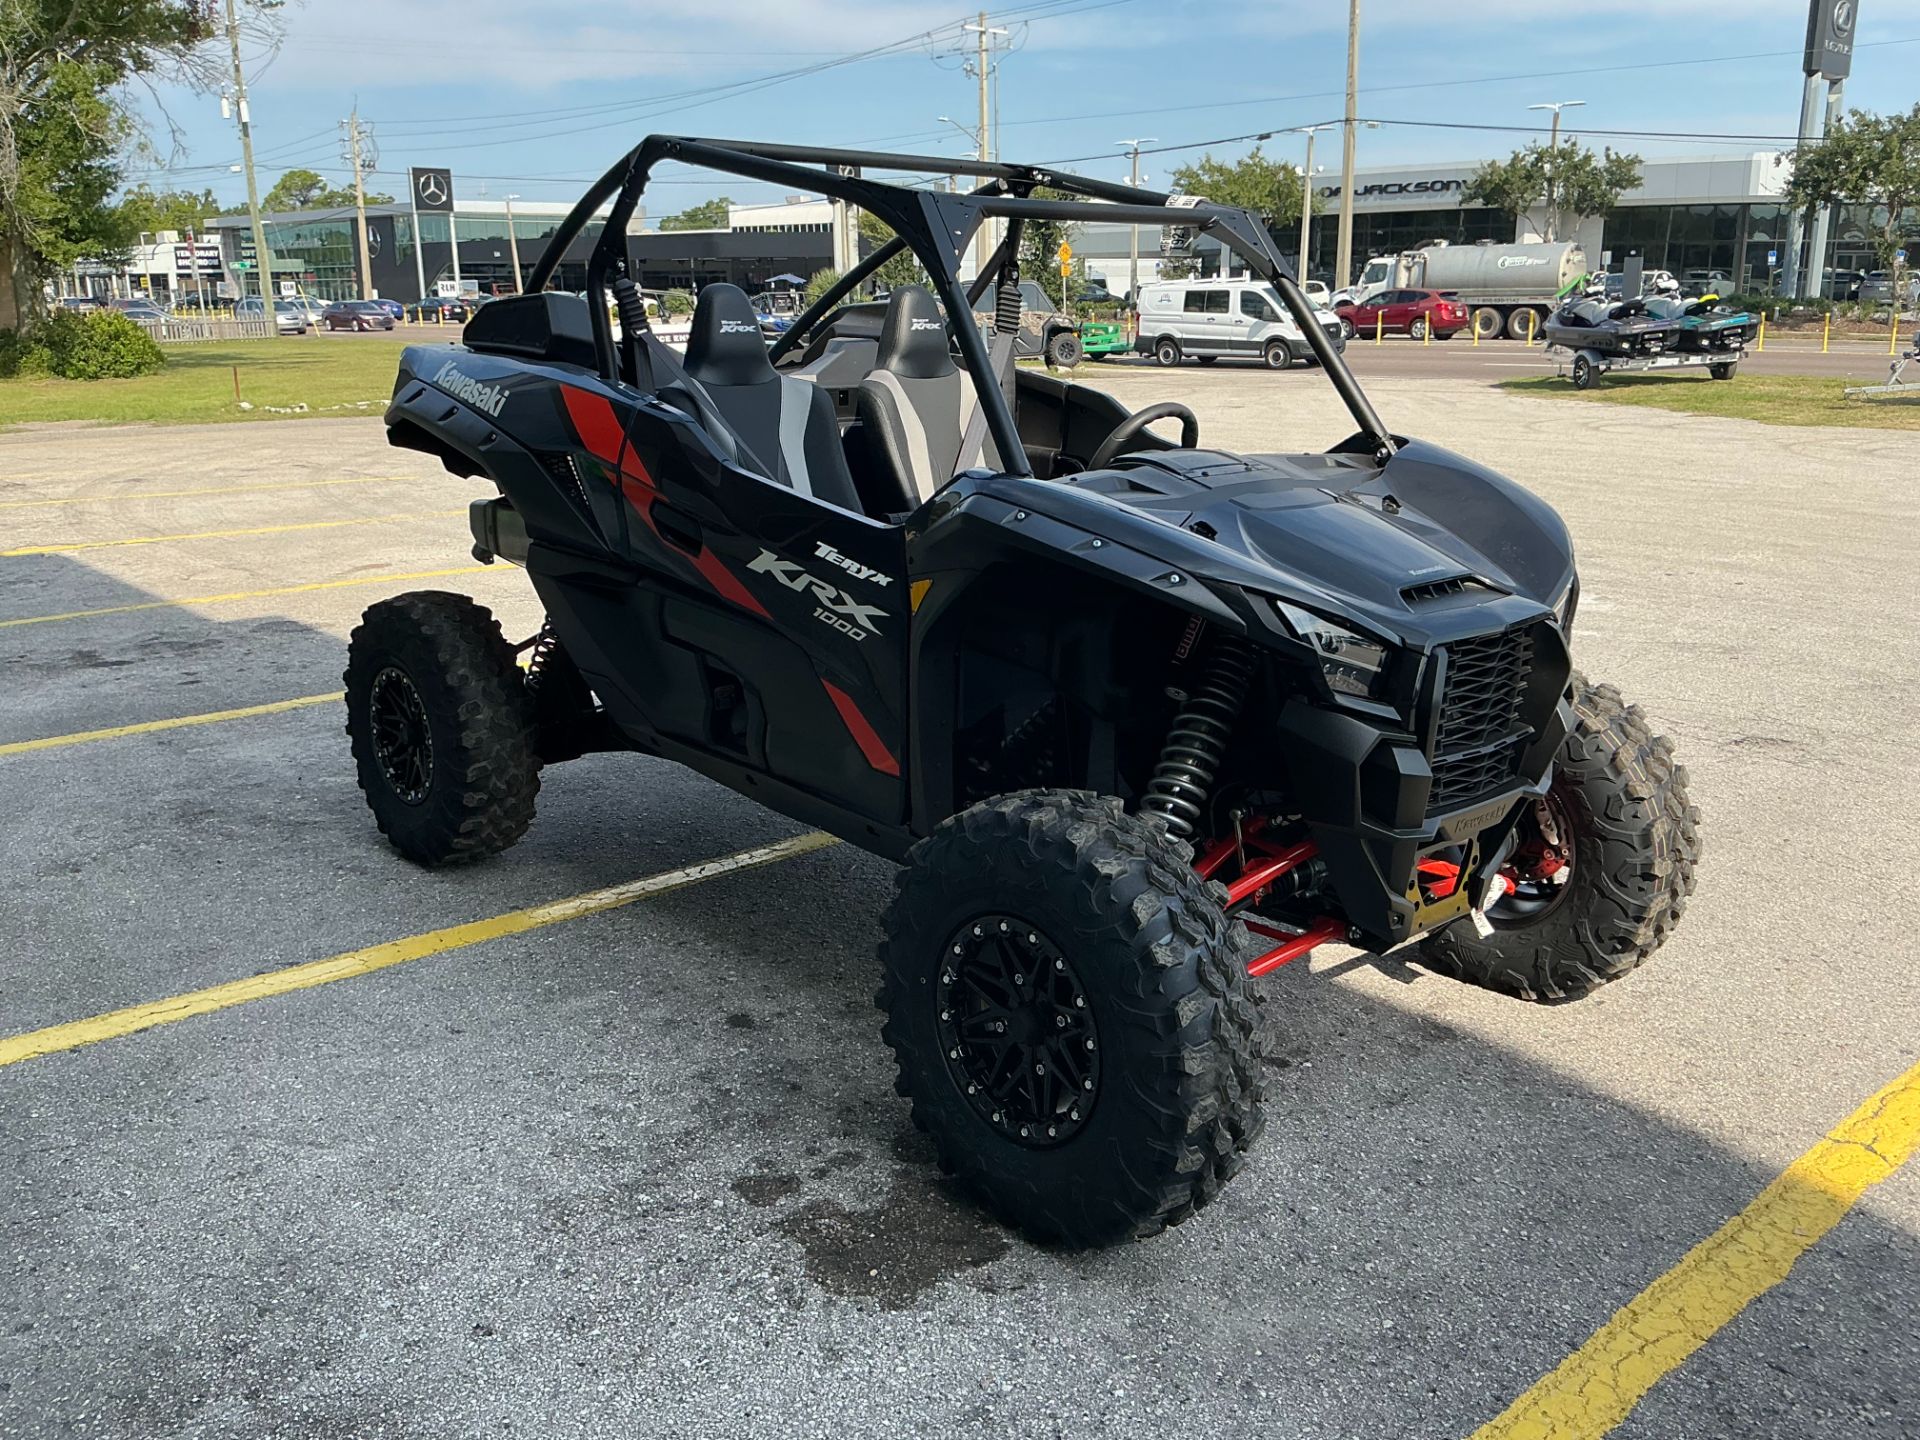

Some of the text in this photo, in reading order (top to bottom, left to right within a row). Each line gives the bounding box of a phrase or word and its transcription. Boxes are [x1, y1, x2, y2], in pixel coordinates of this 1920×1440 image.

[433, 360, 510, 418] Kawasaki
[814, 541, 894, 587] TERYX
[746, 546, 891, 637] KRX
[813, 607, 867, 641] 1000
